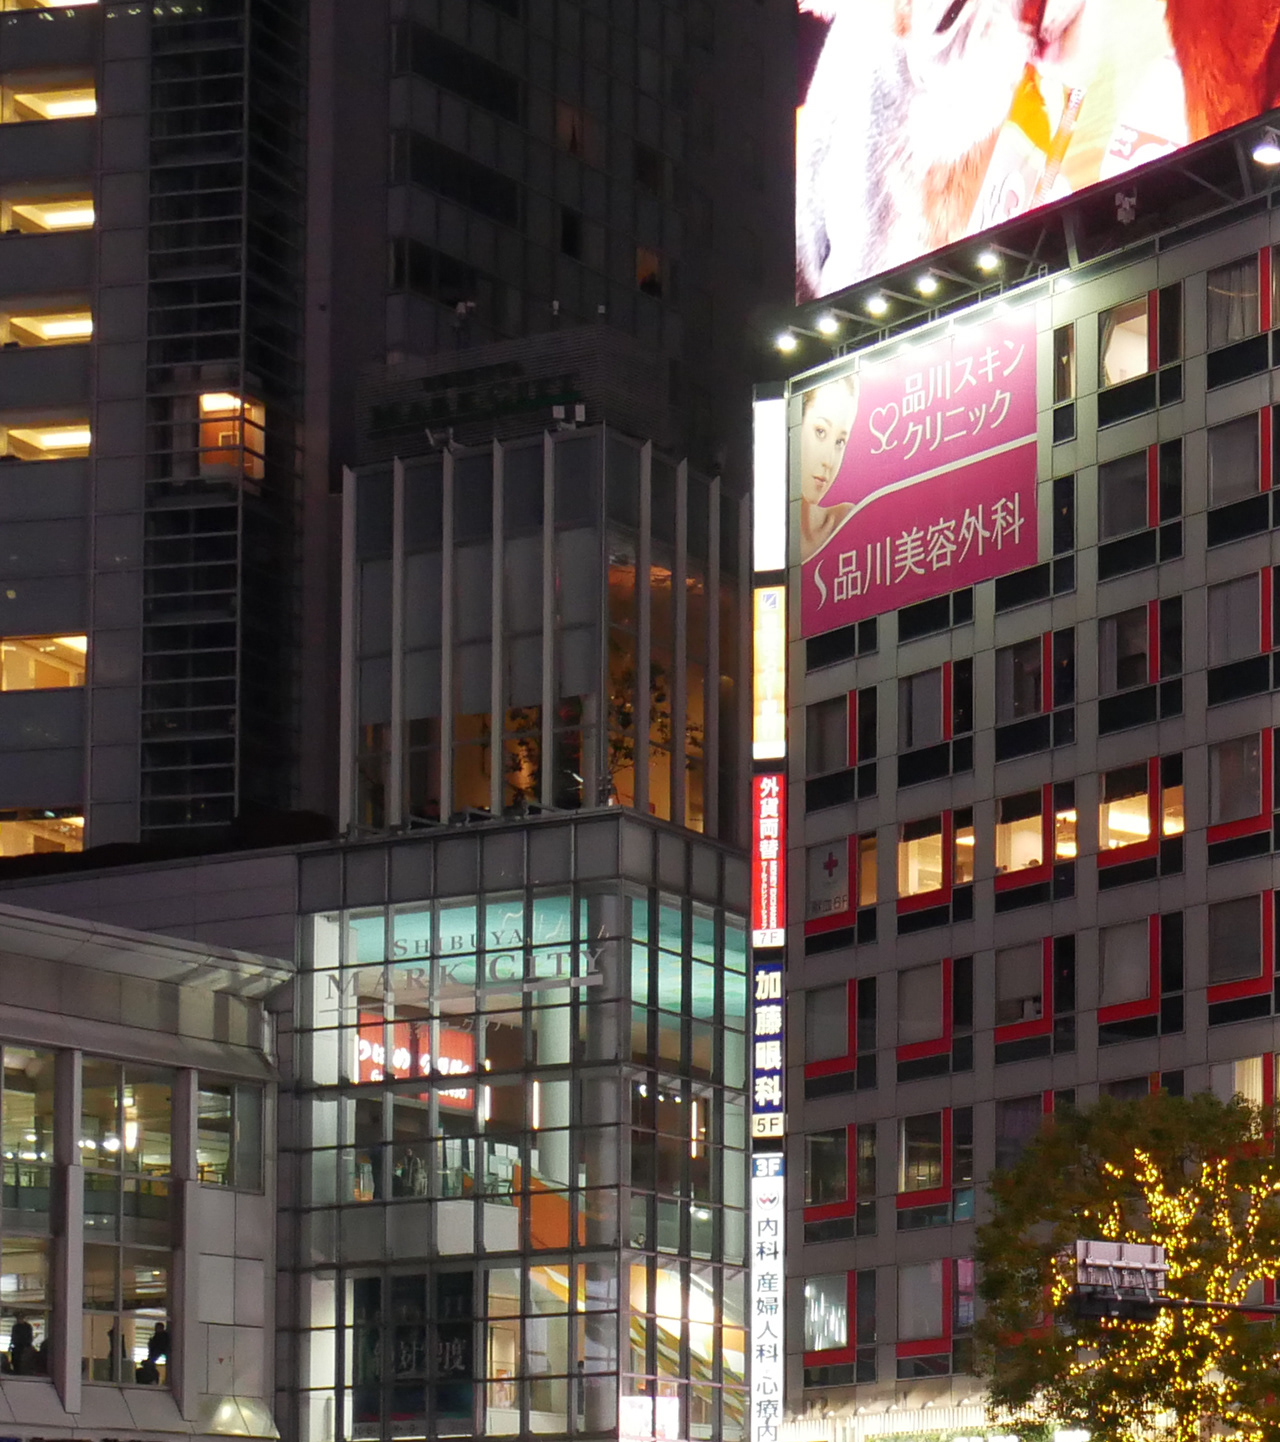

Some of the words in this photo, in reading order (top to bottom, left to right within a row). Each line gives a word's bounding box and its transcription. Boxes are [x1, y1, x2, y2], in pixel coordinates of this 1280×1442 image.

[900, 339, 1026, 413] 品川スキン
[901, 388, 1012, 462] クリニック
[832, 492, 1025, 604] 品川美容外科
[760, 776, 780, 861] 外貨両替
[393, 929, 524, 957] SHIBUYA
[759, 931, 779, 945] 7F
[325, 963, 462, 1000] MARK
[488, 948, 604, 983] CITY
[755, 970, 782, 1107] 加藤眼科
[757, 1117, 780, 1133] 5F
[755, 1158, 781, 1177] 3F
[755, 1217, 779, 1260] 内科
[755, 1271, 779, 1364] 産婦人科
